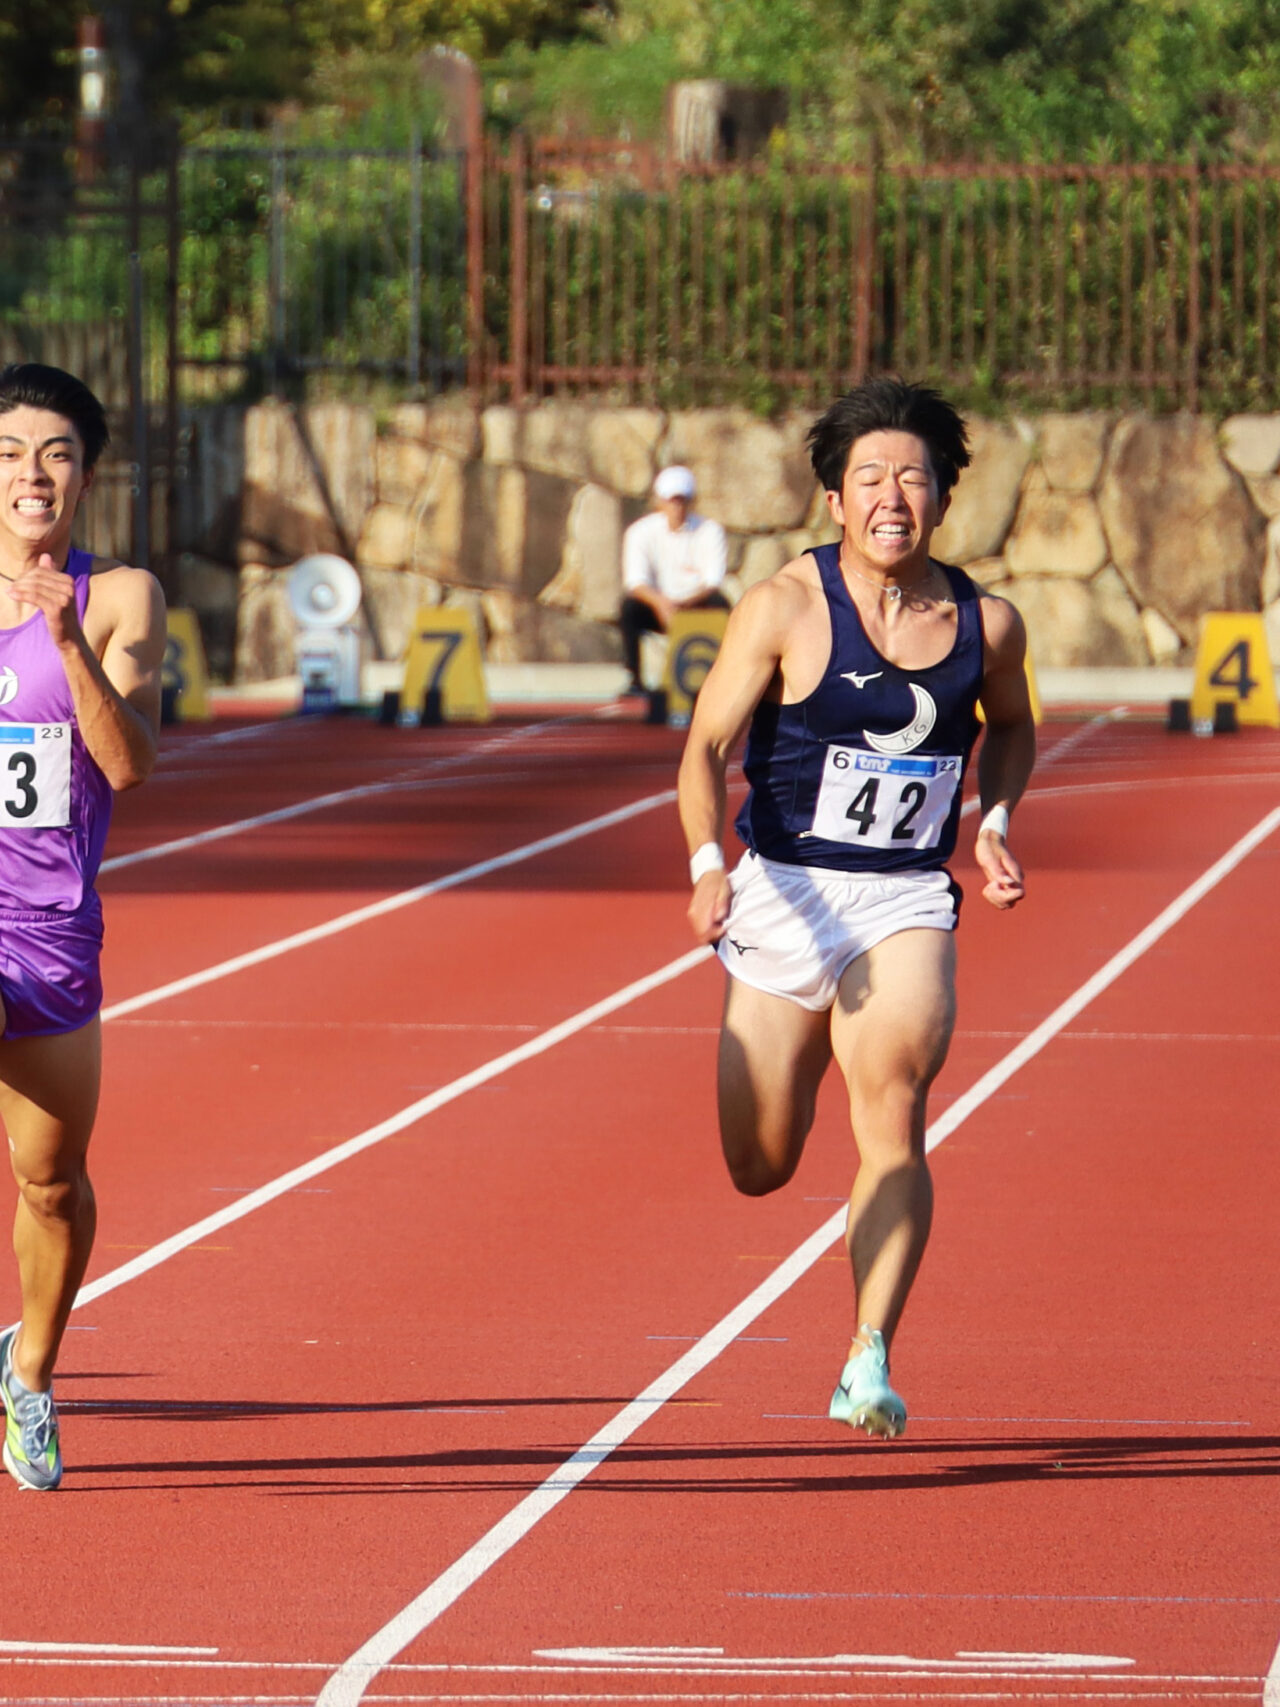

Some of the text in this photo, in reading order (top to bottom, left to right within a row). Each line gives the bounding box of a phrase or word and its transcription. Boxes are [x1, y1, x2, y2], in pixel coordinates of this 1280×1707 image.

[421, 631, 463, 695] 7
[674, 636, 719, 699] 6
[1209, 638, 1259, 700] 4
[41, 727, 64, 739] 23
[833, 751, 851, 770] 6
[940, 760, 957, 772] 23
[845, 777, 928, 840] 42
